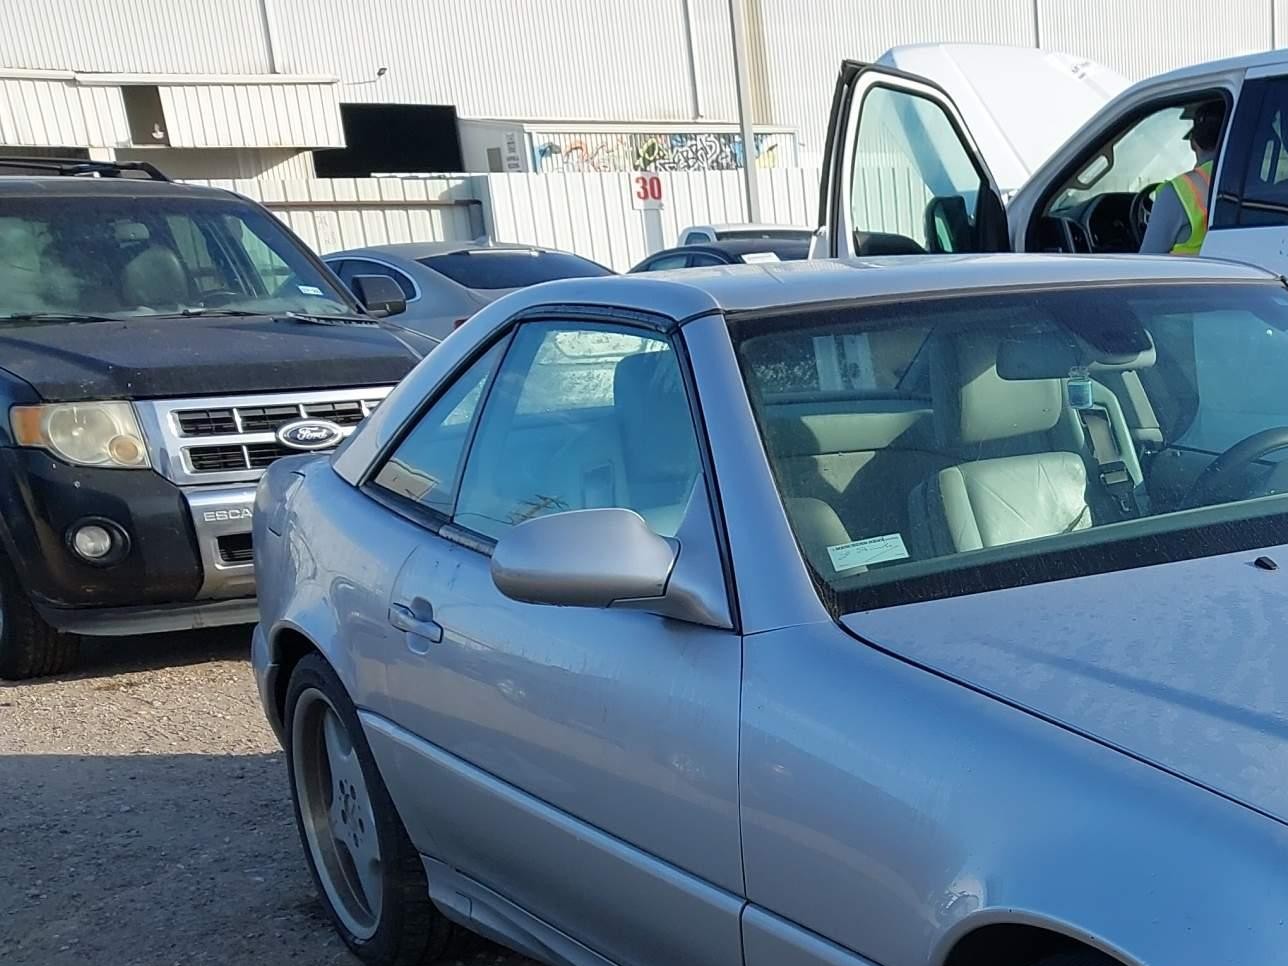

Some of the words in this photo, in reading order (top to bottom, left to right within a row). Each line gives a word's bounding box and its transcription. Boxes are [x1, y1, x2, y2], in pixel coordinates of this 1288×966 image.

[635, 176, 662, 200] 30
[297, 427, 327, 440] Ford
[203, 509, 253, 521] ESCA
